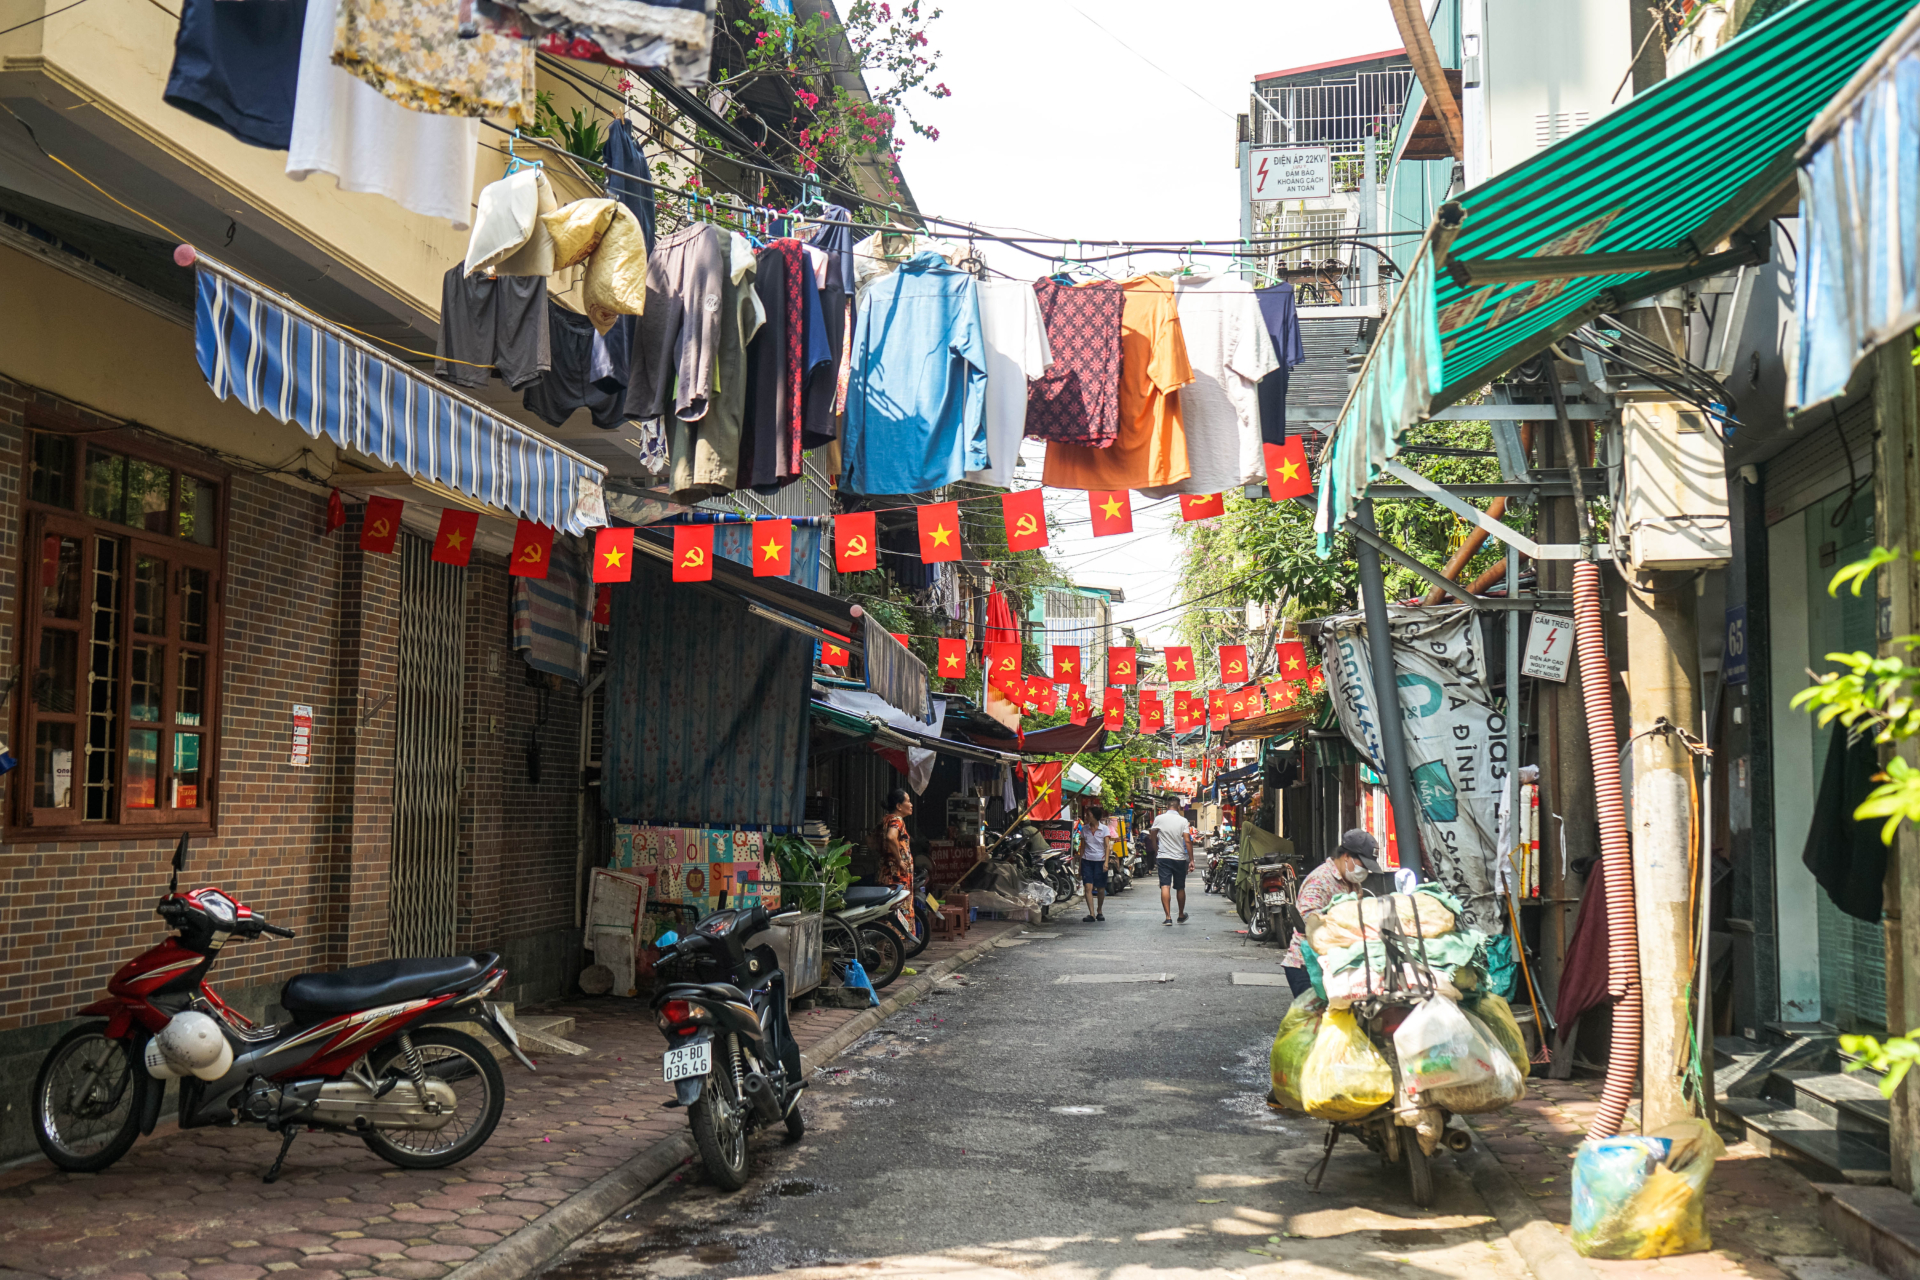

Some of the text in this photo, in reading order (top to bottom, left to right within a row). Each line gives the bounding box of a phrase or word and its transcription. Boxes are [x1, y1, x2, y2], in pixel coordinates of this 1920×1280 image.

[1274, 154, 1291, 167] ĐIỆN
[1293, 153, 1304, 165] ÁP
[1534, 616, 1550, 626] CẤM
[1728, 618, 1744, 657] 65
[1452, 724, 1477, 793] ĐỈNH
[1418, 779, 1433, 806] NĂM
[1041, 829, 1071, 841] RBER
[749, 843, 760, 859] R
[1050, 842, 1071, 851] SHOP
[671, 864, 681, 881] V
[713, 863, 722, 881] S
[723, 875, 734, 891] T
[762, 875, 774, 892] U
[670, 1045, 703, 1065] 29-BD
[666, 1058, 707, 1079] 036.46
